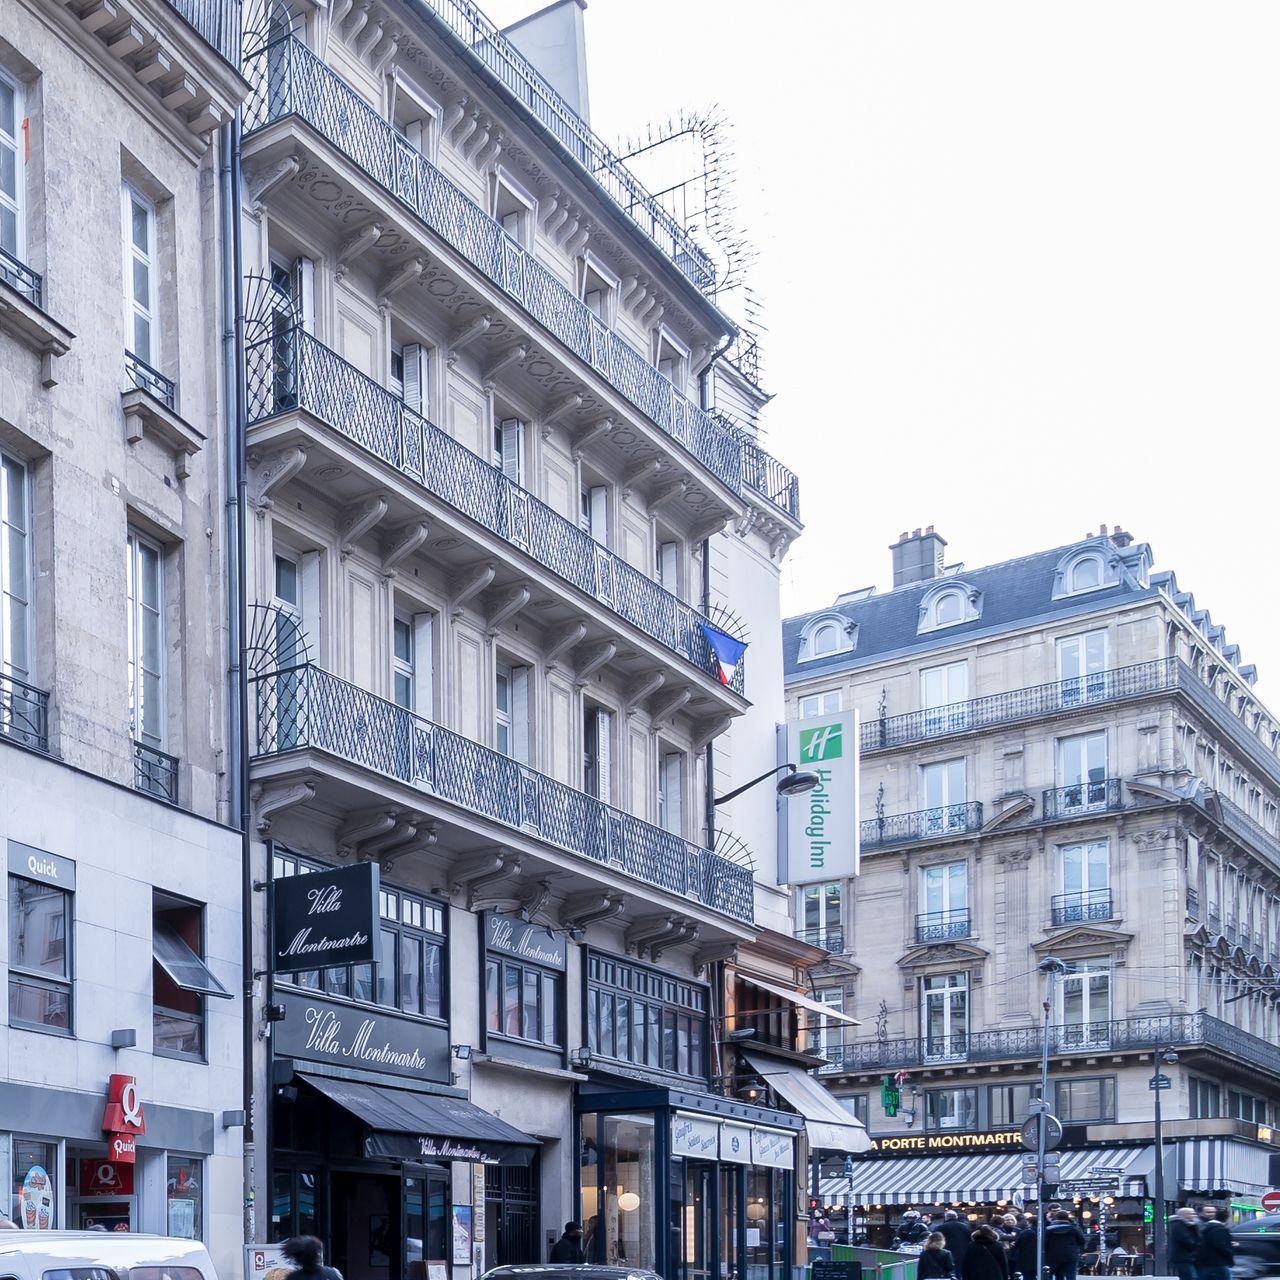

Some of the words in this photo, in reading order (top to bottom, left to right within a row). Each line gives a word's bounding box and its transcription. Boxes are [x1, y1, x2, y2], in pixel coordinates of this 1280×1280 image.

[28, 856, 58, 879] Quick
[810, 841, 832, 868] Inn
[307, 885, 343, 915] Villa
[278, 926, 369, 957] Montmartre
[490, 917, 514, 950] Villa
[512, 928, 562, 966] Montmartre
[305, 1007, 341, 1055] Villa
[342, 1019, 427, 1070] Montmartre
[122, 1083, 142, 1127] Q
[419, 1136, 436, 1155] Villa
[882, 1137, 926, 1150] PORTE
[929, 1132, 1023, 1147] MONTMARTR
